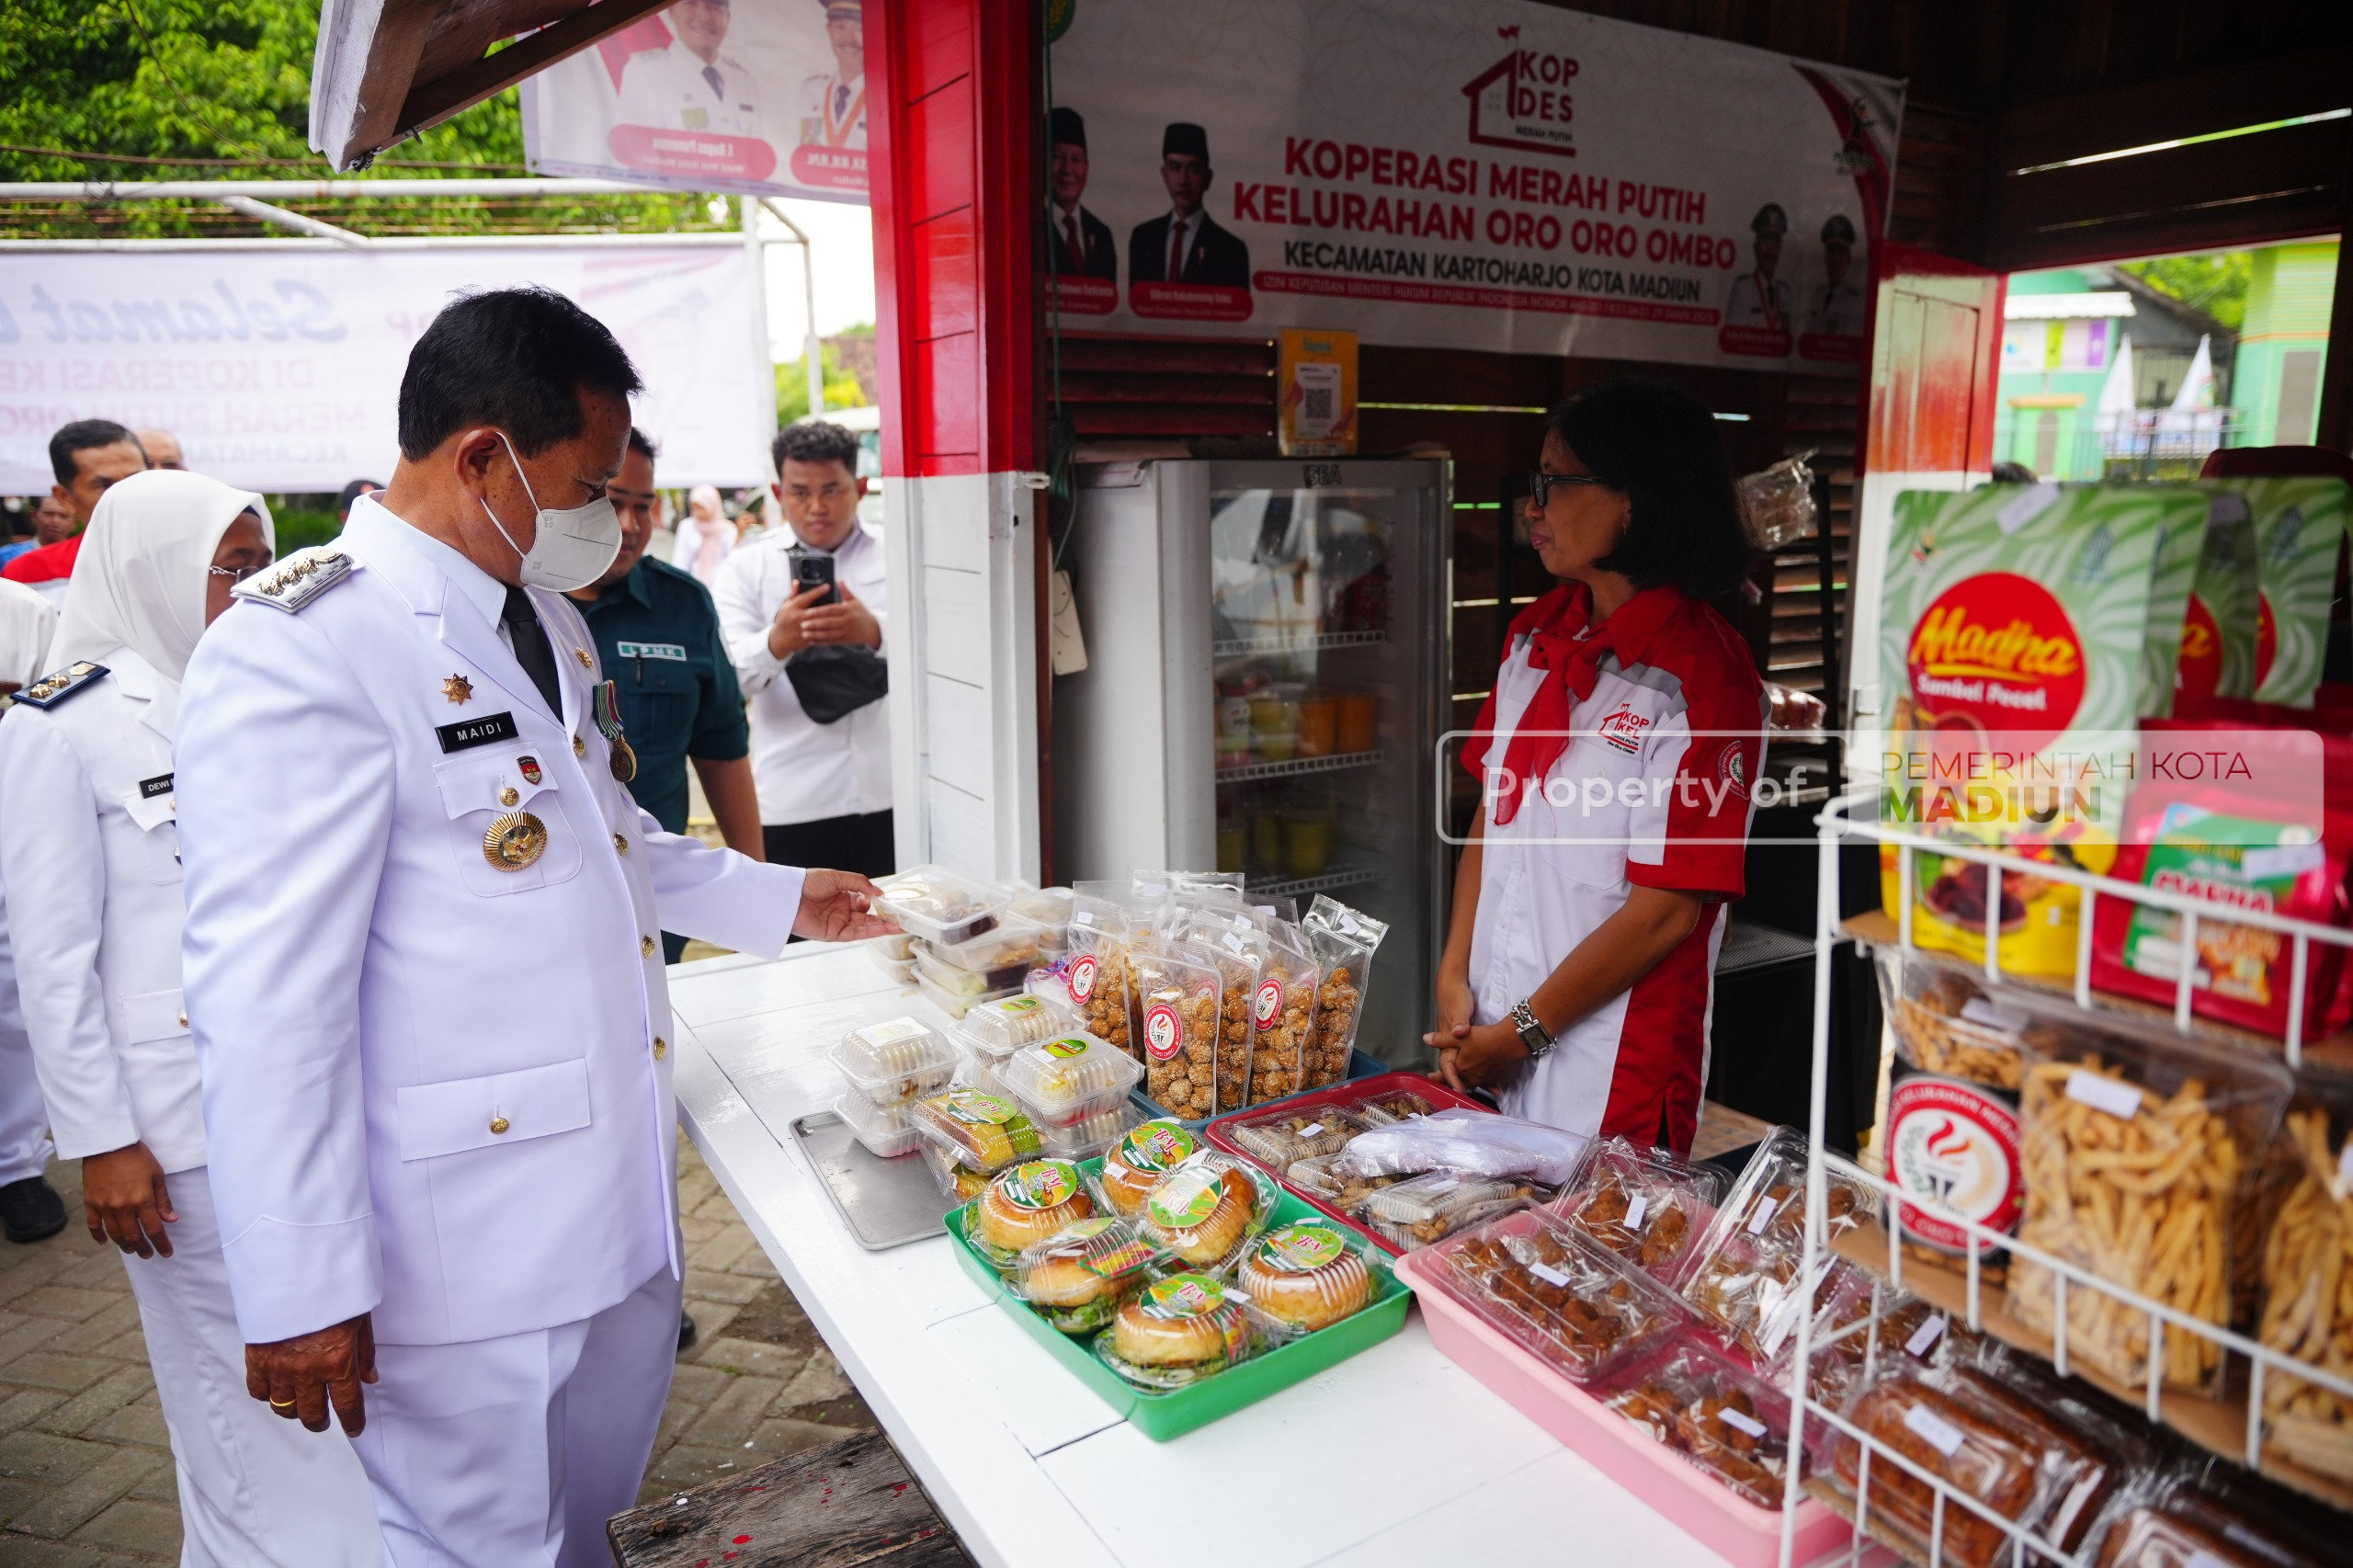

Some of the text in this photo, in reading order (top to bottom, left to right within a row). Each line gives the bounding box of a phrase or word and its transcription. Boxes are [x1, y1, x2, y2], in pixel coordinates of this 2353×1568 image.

[1518, 50, 1580, 86] KOP
[1518, 87, 1573, 122] DES
[1285, 136, 1706, 224] KOPERASI MERAH PUTIH
[1234, 182, 1736, 270] KELURAHAN ORO ORO OMBO
[1285, 241, 1700, 303] KECAMATAN KARTOHARJO KOTA MADIUN
[457, 722, 502, 741] MAIDI
[1617, 722, 1640, 740] KEL
[1622, 711, 1650, 727] KOP
[148, 780, 170, 791] DEWI
